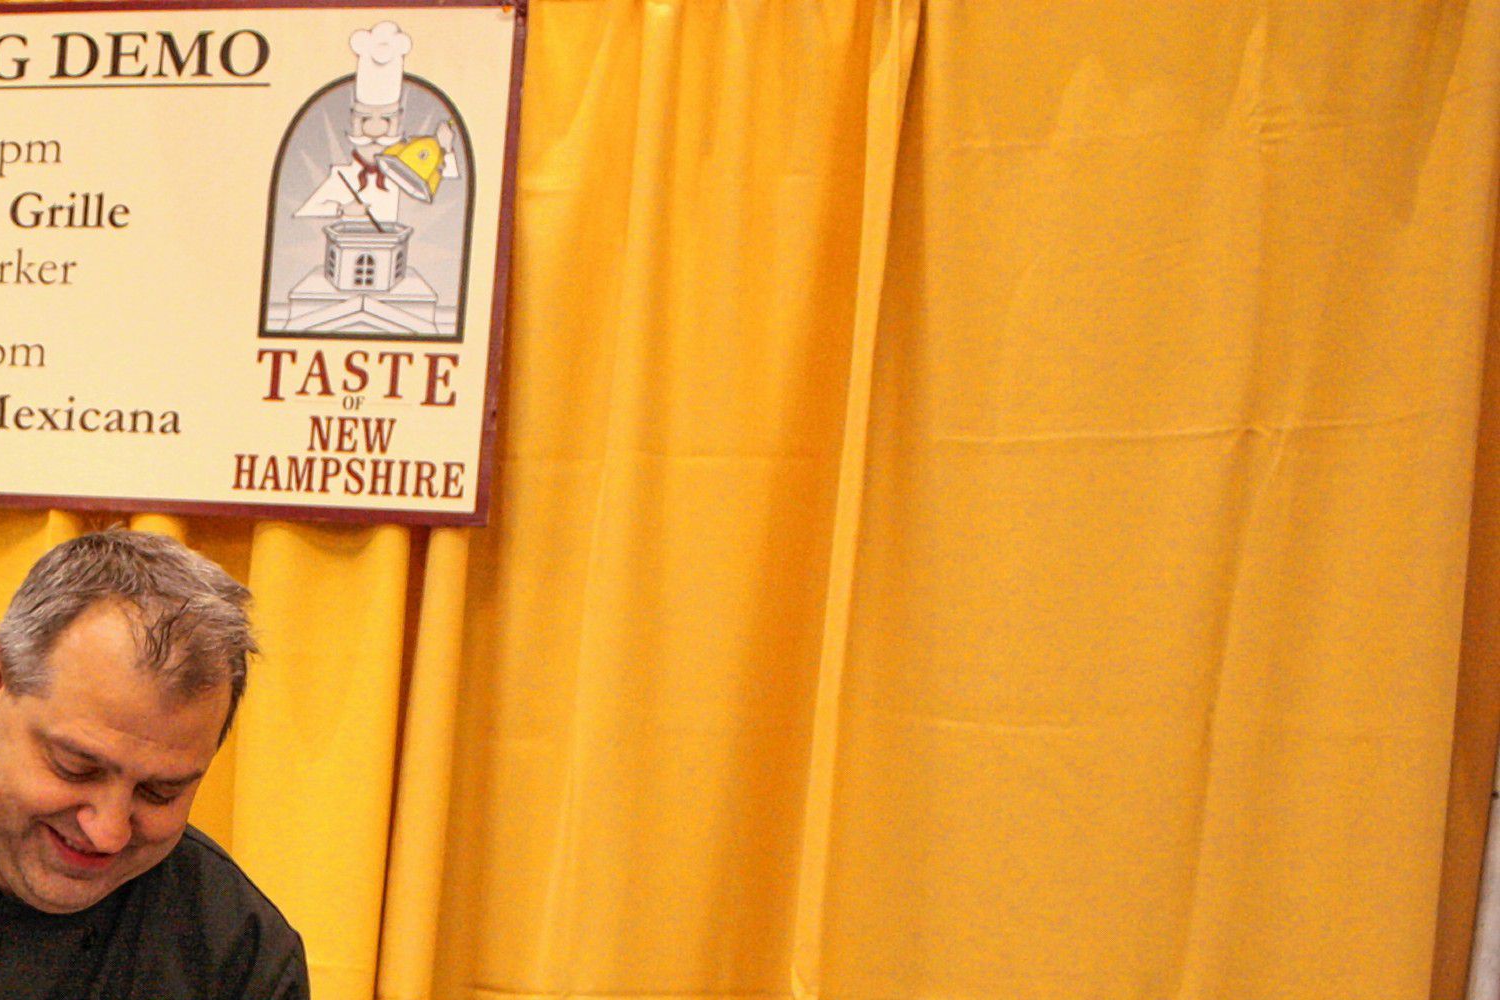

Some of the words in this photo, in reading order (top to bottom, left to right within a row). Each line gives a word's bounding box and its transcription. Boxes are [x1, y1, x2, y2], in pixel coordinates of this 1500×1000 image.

[49, 29, 271, 79] DEMO
[9, 191, 131, 229] Grille
[256, 347, 460, 407] TASTE
[342, 395, 366, 411] OF
[306, 414, 397, 455] NEW
[231, 453, 466, 499] HAMPSHIRE
